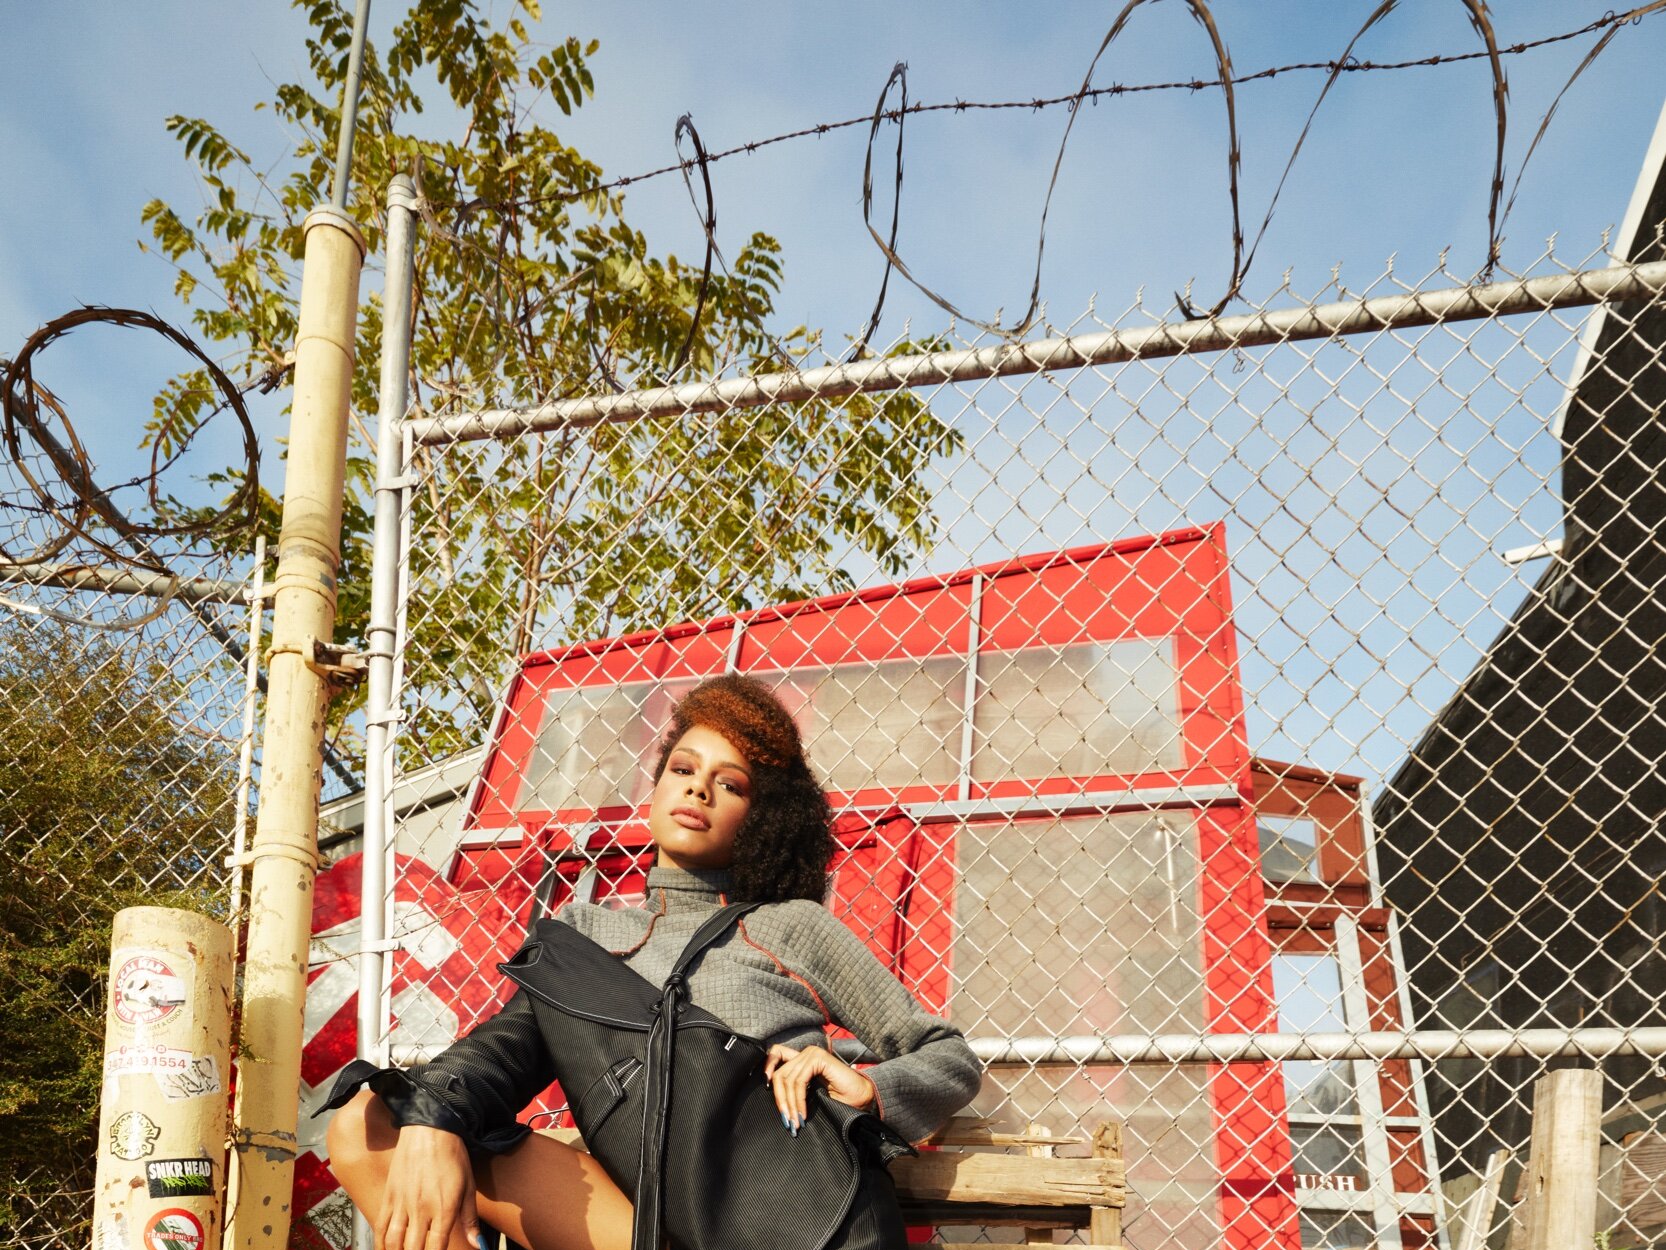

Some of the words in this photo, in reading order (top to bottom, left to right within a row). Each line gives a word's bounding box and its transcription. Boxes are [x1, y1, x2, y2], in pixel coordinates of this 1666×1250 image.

[138, 958, 165, 974] MAN
[166, 1008, 183, 1024] COUCH
[112, 1113, 155, 1136] BROOLYN
[113, 1142, 148, 1156] TATOO
[148, 1161, 184, 1180] SNKR
[183, 1161, 211, 1177] HEAD
[147, 1232, 173, 1240] TRADES
